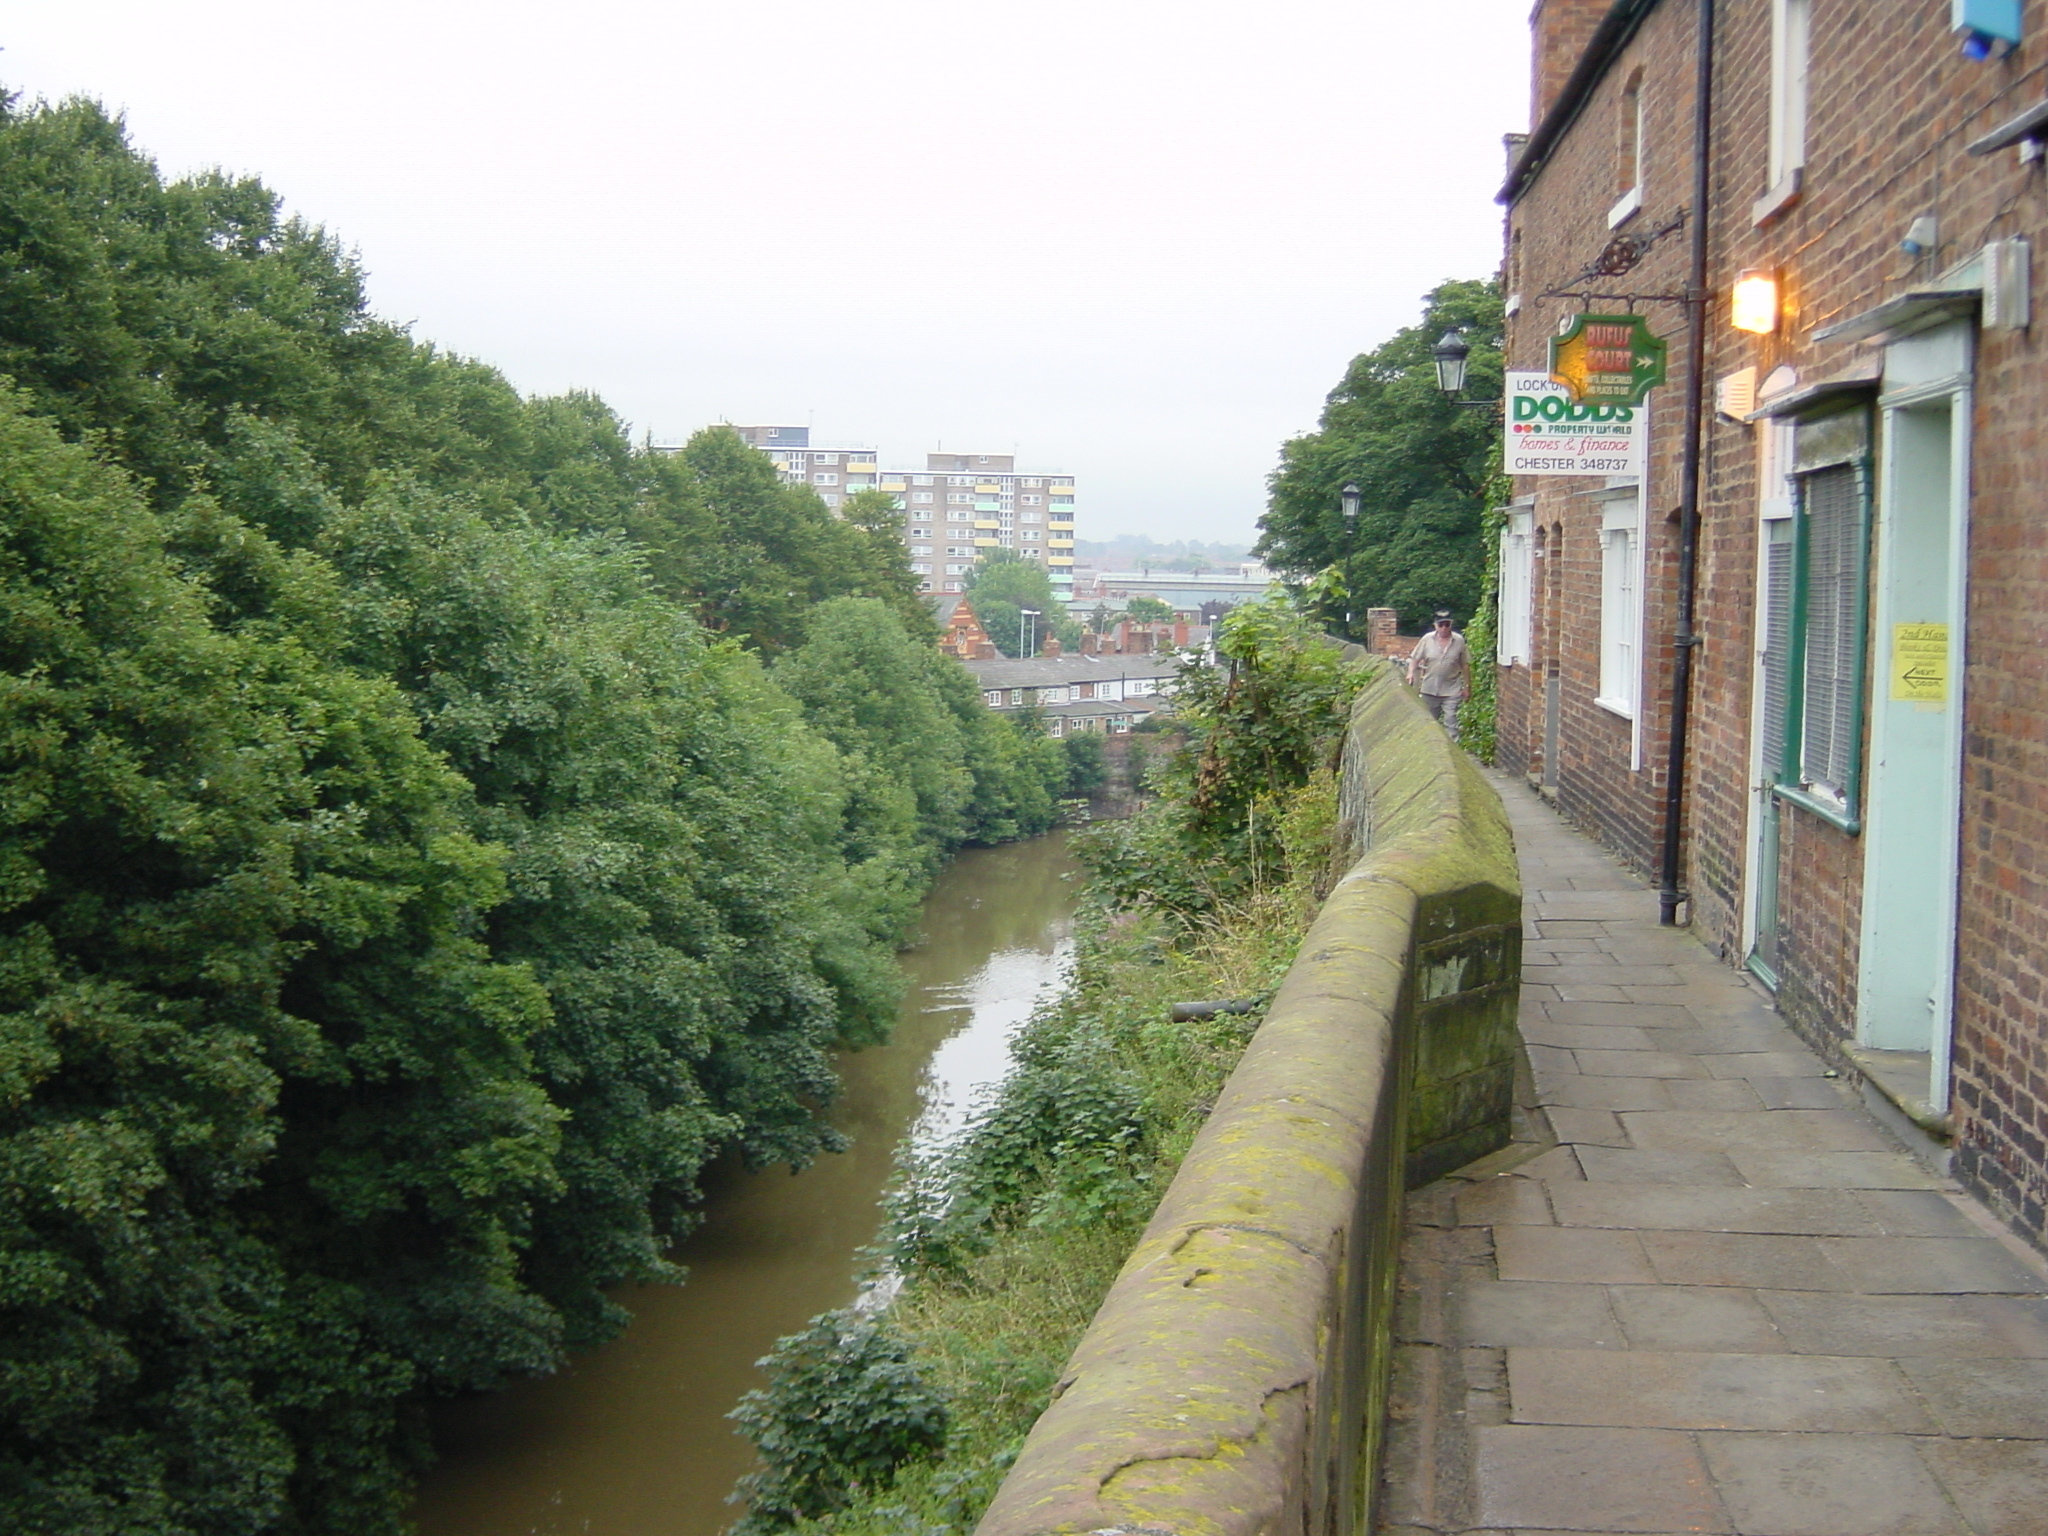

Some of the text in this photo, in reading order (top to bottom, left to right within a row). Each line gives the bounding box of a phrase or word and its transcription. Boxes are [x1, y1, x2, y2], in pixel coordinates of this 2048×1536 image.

[1586, 326, 1632, 347] RUFUS
[1585, 350, 1632, 372] COURT
[1517, 379, 1562, 391] LOCK U
[1513, 395, 1634, 422] DODDS
[1548, 424, 1594, 434] PROPERTY
[1519, 435, 1629, 456] homes & finance
[1515, 457, 1628, 470] CHESTER 348737
[1899, 628, 1921, 640] 2nd
